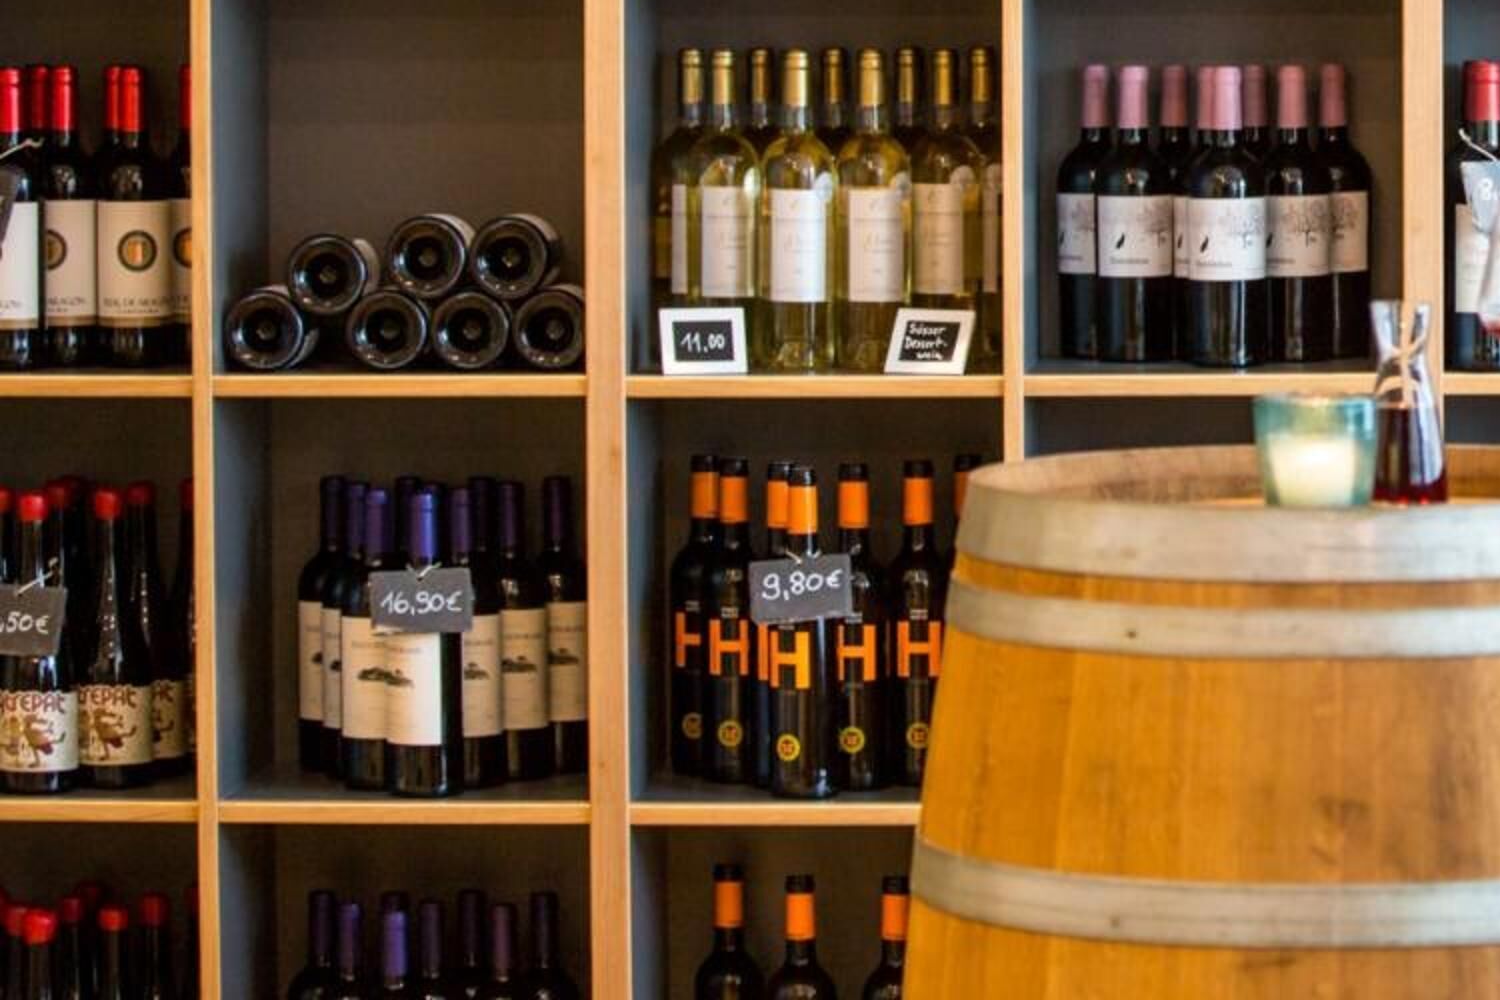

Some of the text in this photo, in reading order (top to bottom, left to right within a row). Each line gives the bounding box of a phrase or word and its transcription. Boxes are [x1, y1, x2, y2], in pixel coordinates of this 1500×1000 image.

[379, 589, 463, 617] 16,90€
[760, 568, 844, 601] 9,80€
[709, 619, 748, 676] H
[769, 631, 810, 689] H
[836, 624, 876, 682] H
[897, 620, 941, 678] H
